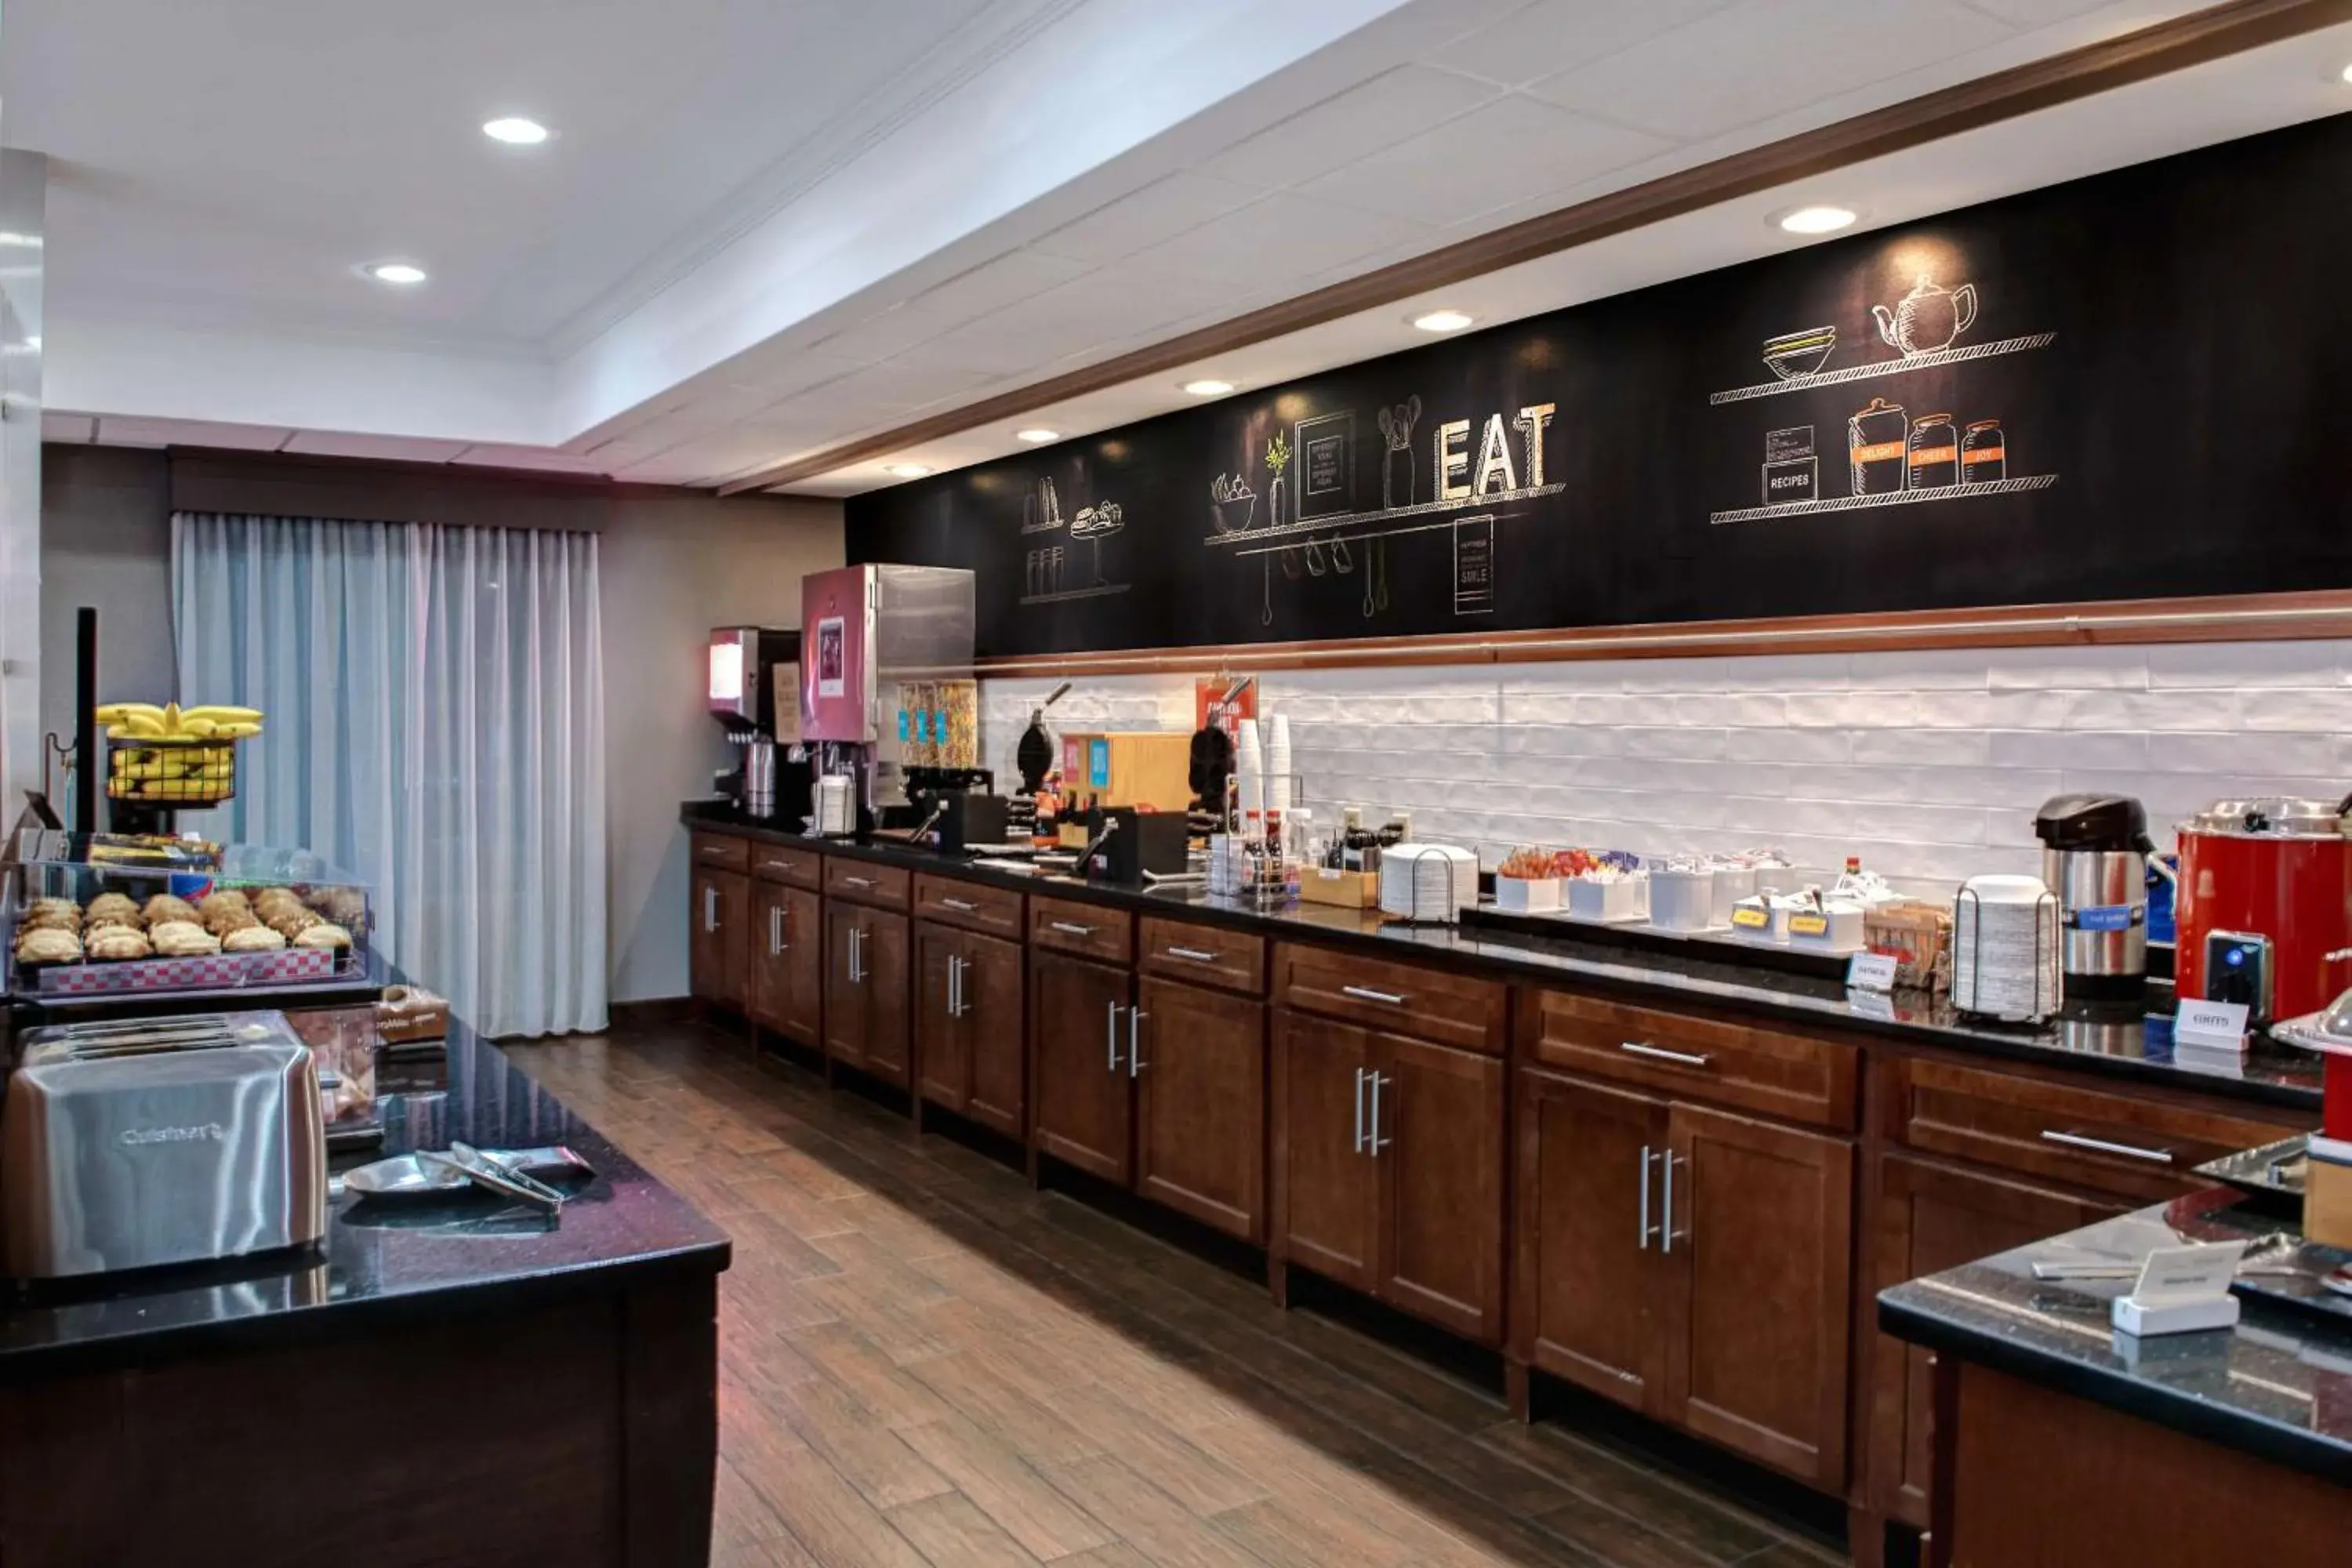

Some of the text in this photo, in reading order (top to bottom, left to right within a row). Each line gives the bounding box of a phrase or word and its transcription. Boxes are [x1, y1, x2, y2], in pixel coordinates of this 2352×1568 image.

[1435, 402, 1555, 502] EAT
[1918, 448, 1948, 463] CHEER
[1976, 449, 1992, 461] JOY
[1771, 474, 1809, 488] RECIPES
